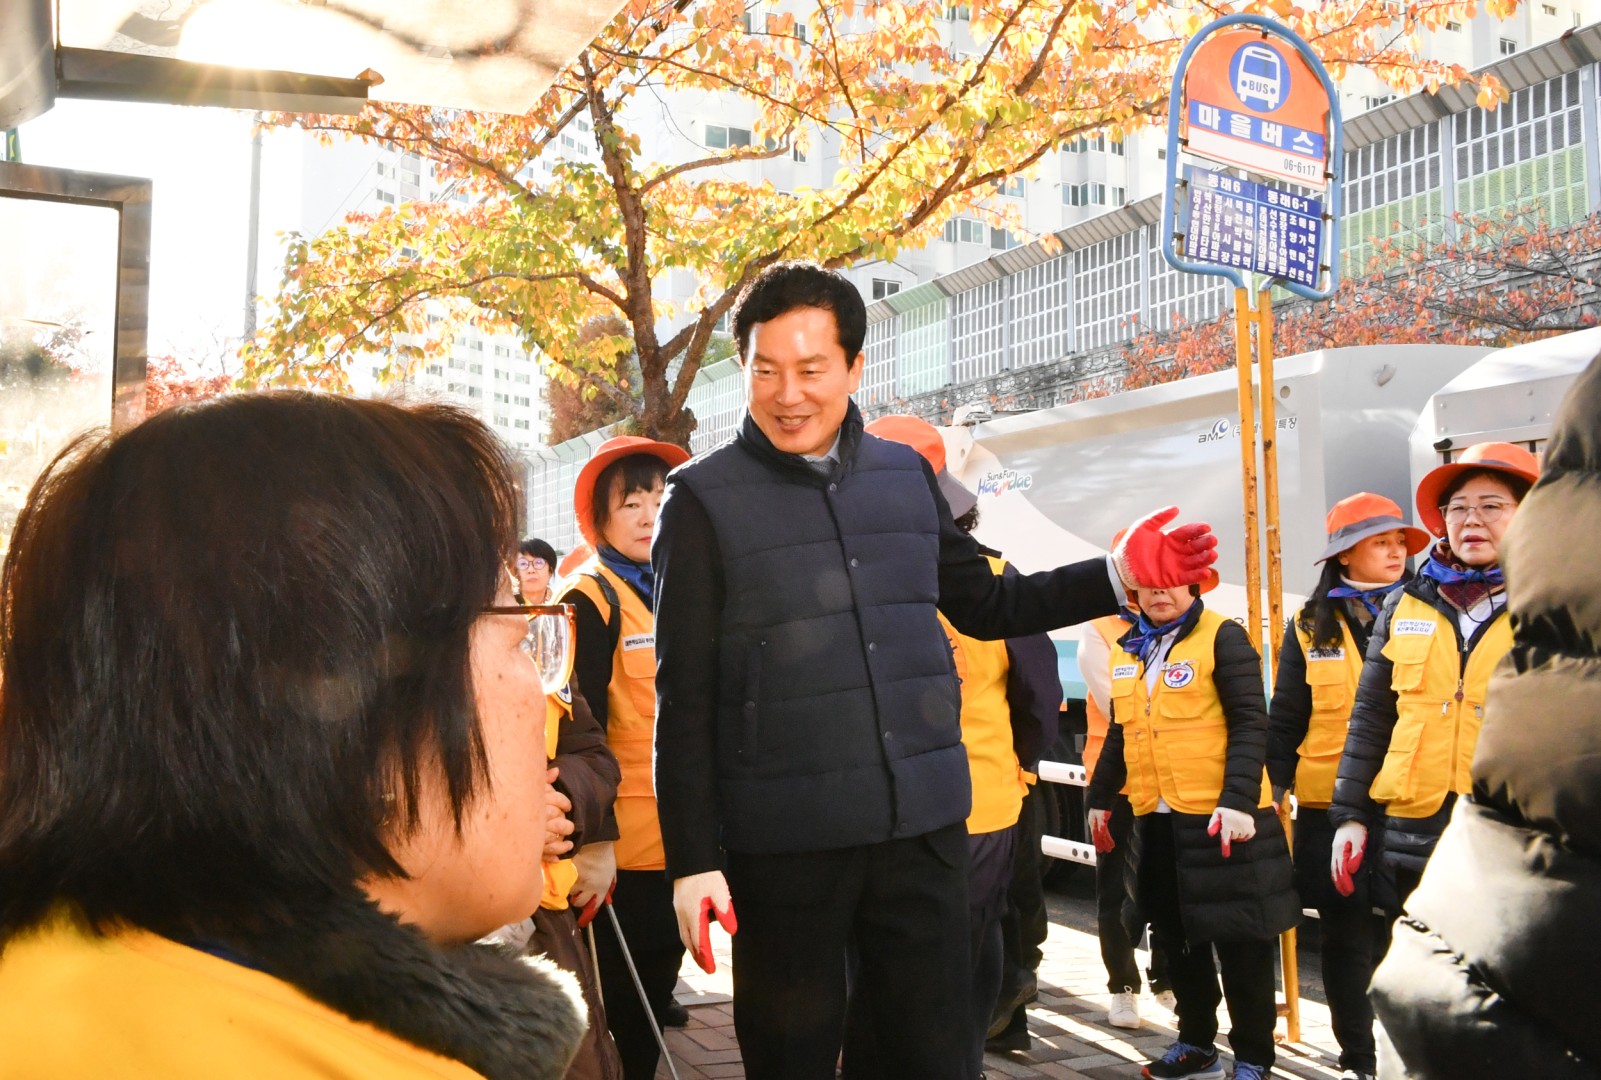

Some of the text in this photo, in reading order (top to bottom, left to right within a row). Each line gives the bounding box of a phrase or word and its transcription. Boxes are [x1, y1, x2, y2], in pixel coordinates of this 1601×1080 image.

[1249, 80, 1269, 95] BUS
[1198, 104, 1314, 155] 마을버스
[1283, 158, 1316, 177] 06-6117
[1207, 173, 1241, 193] 동래6
[1267, 190, 1308, 212] 동래6-1
